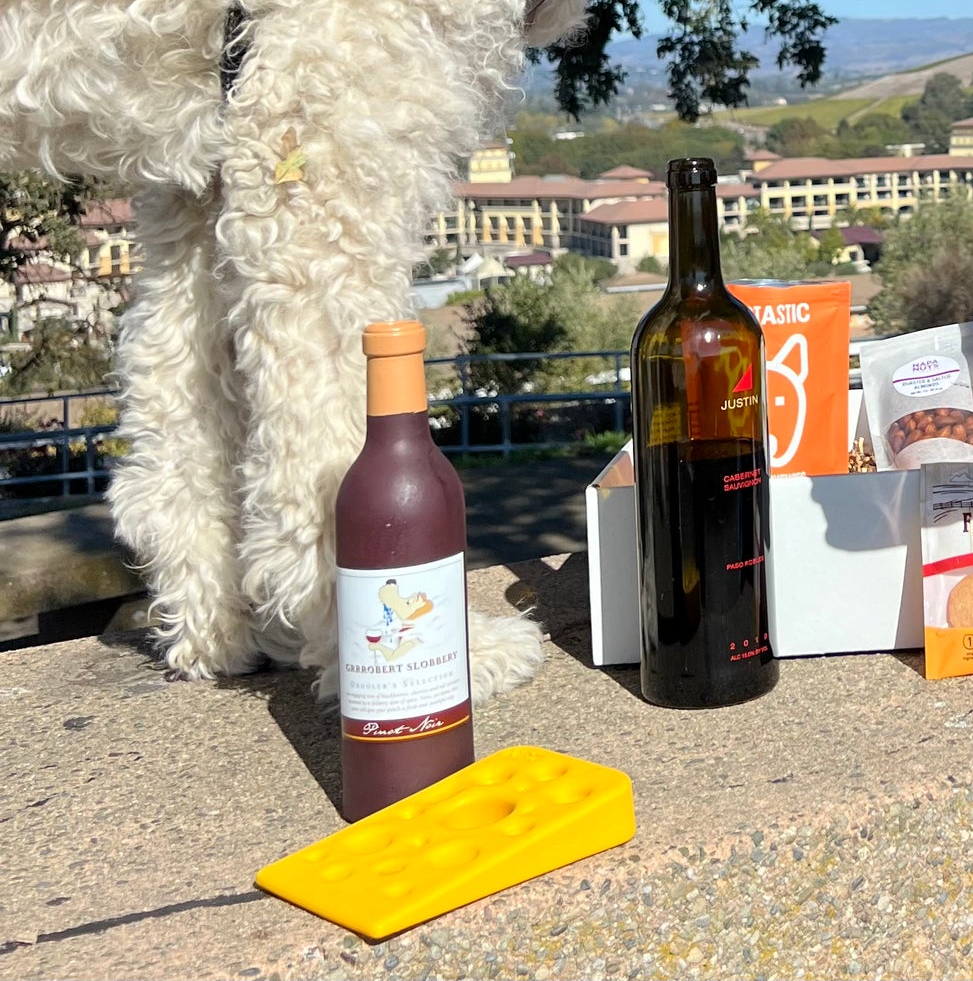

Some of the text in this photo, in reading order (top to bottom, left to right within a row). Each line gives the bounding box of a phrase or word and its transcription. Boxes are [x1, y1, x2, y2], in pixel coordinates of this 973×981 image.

[750, 302, 811, 325] TASTIC
[721, 395, 758, 410] JUSTIN
[723, 468, 761, 483] CABERNET
[724, 477, 762, 491] SAUVIGNON
[345, 651, 458, 674] GRRROBERT SLOBBERY
[730, 653, 741, 661] ALC
[363, 715, 444, 736] Pinot Noir
